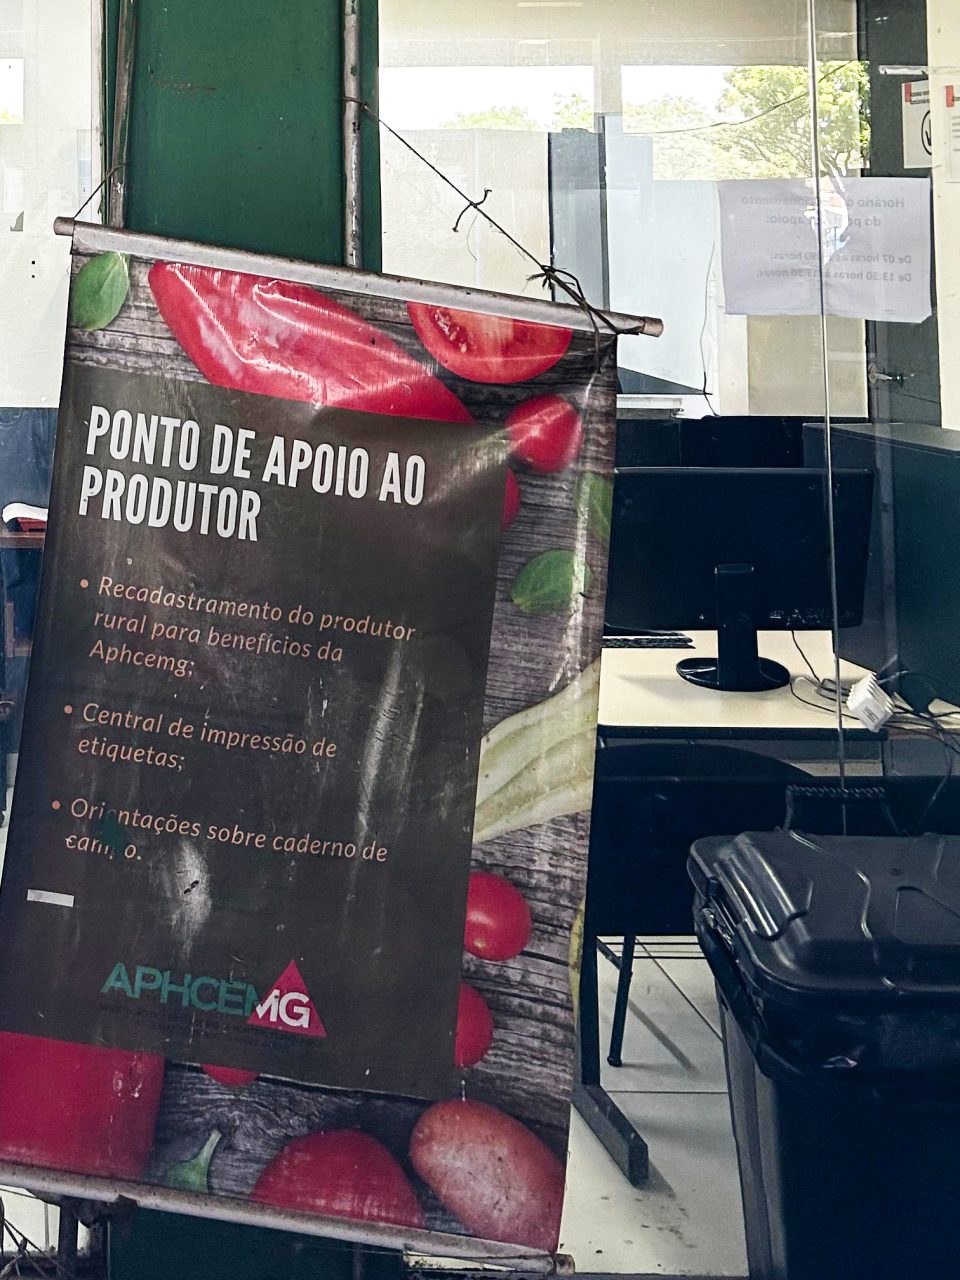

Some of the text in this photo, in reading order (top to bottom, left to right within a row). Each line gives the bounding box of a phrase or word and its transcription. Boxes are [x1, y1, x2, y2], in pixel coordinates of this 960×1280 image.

[86, 406, 426, 506] PONTO DE APOIO AO
[78, 466, 262, 541] PRODUTOR
[99, 576, 415, 641] Recadastramento do produtor
[89, 639, 195, 678] Aphcemg;
[94, 610, 343, 663] rural para benefícios da
[78, 736, 186, 771] etiquetas;
[82, 703, 337, 758] Central de impressão de
[207, 823, 265, 849] sobre
[272, 831, 356, 860] caderno
[362, 840, 388, 862] de
